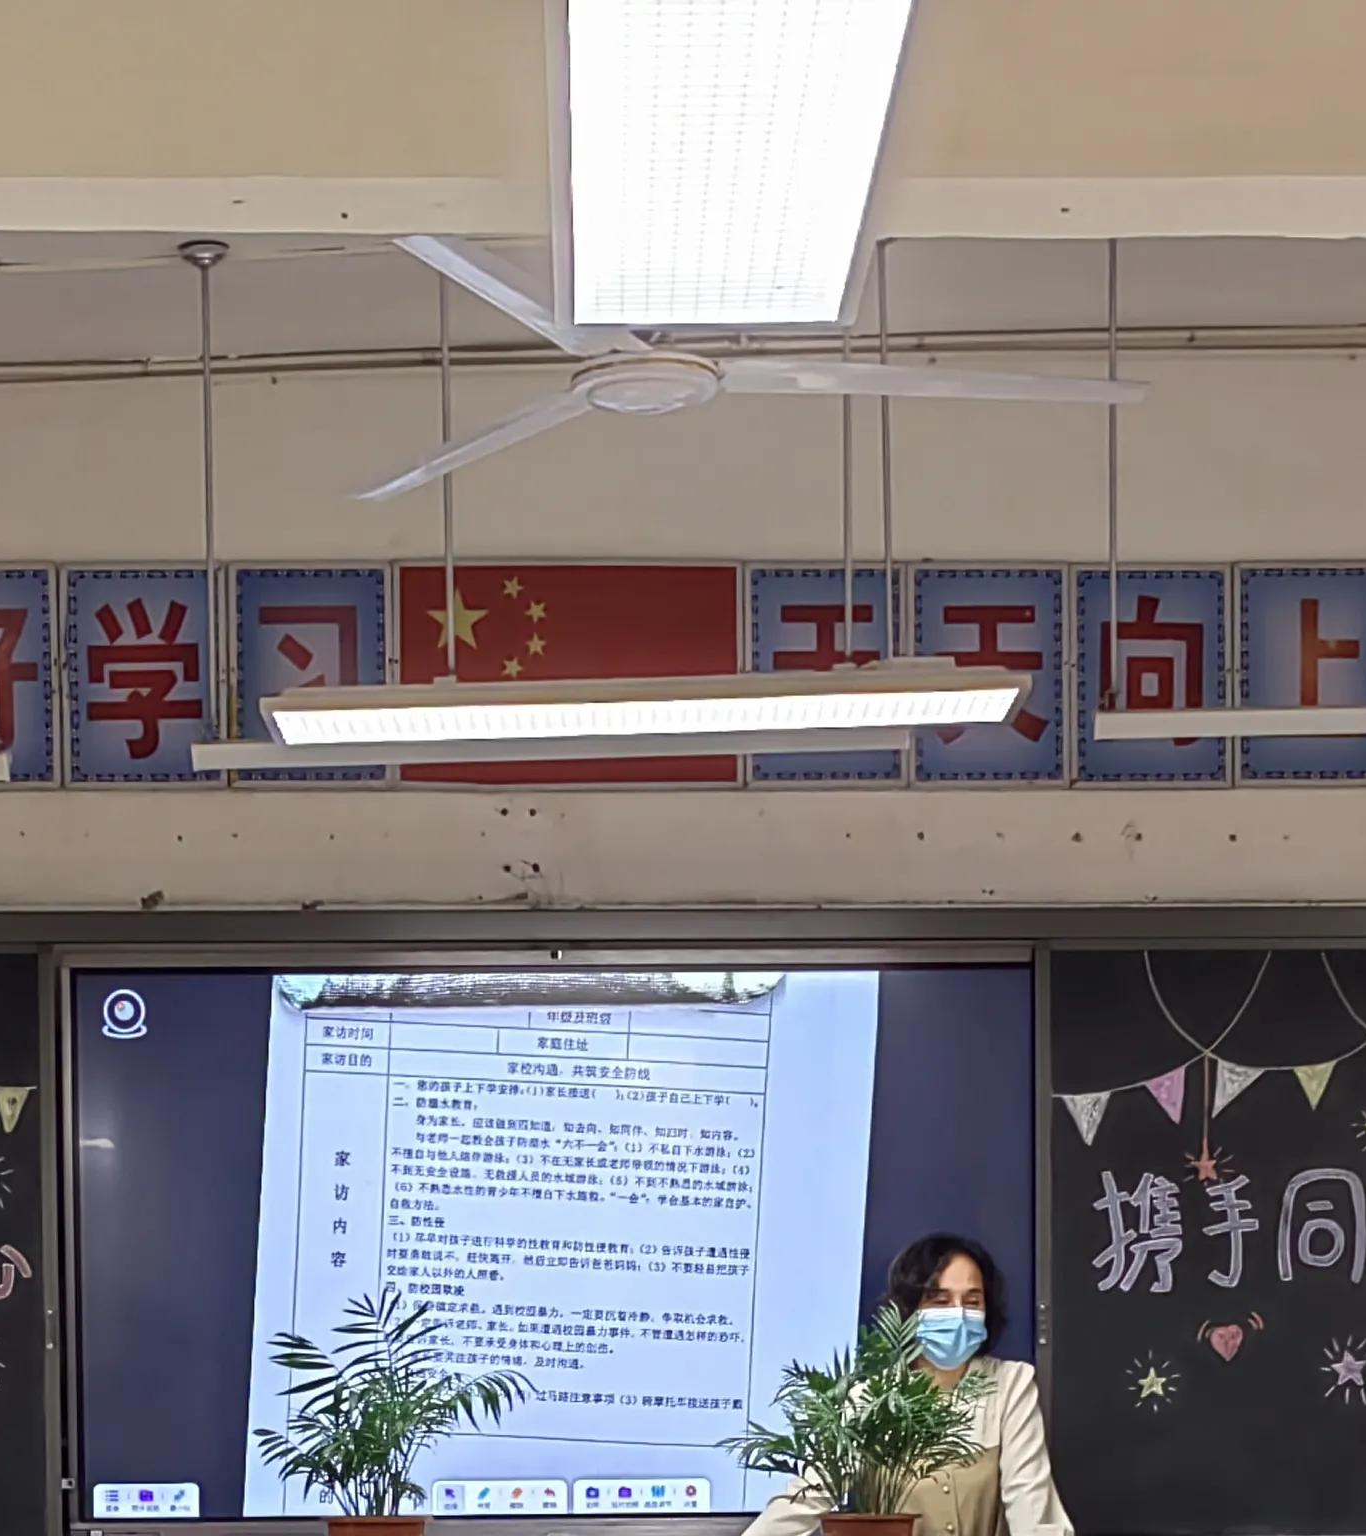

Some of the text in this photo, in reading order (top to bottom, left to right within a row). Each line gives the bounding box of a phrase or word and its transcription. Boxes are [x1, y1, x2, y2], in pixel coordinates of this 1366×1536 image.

[322, 1026, 374, 1041] 家访时间
[537, 1036, 589, 1052] 家庭住址
[321, 1052, 372, 1068] 家访目的
[330, 1149, 352, 1269] 家访内容
